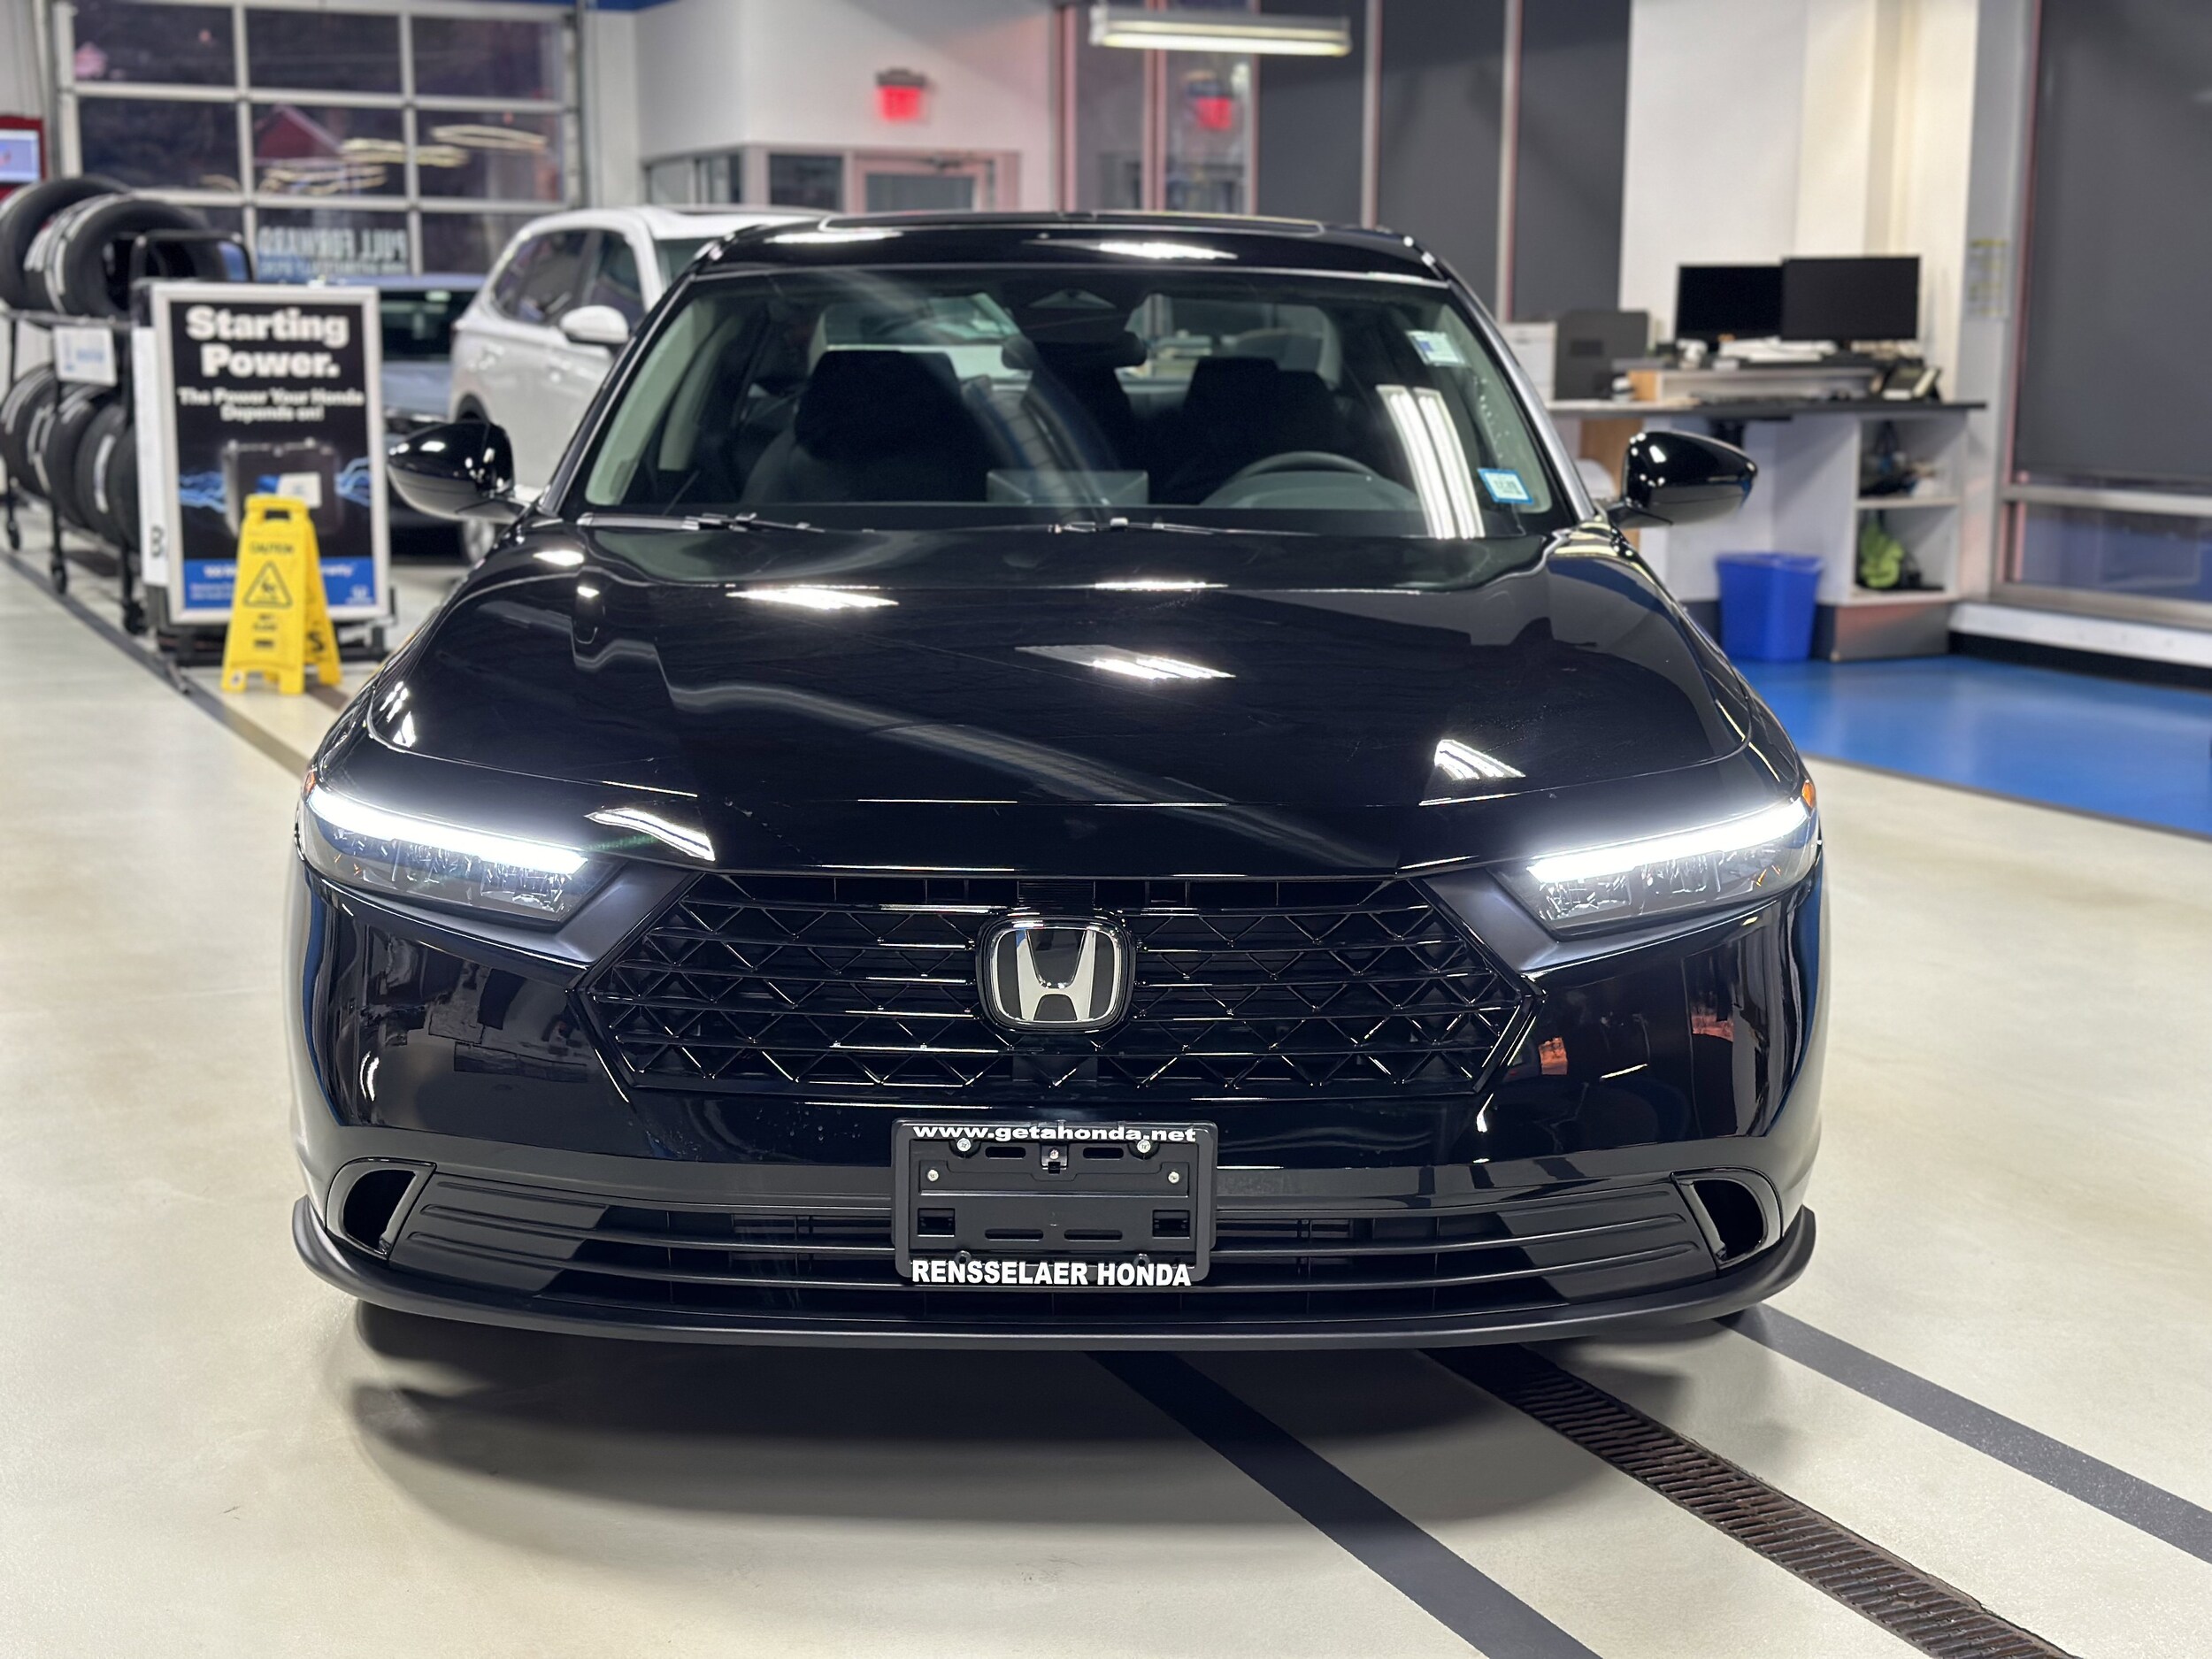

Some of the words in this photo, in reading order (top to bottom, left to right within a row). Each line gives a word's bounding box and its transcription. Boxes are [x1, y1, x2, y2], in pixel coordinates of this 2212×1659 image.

[186, 304, 349, 349] Starting
[200, 342, 341, 378] Power.
[178, 386, 211, 406] The
[212, 386, 267, 407] Power
[269, 387, 309, 407] Your
[310, 387, 365, 407] Honda
[220, 403, 295, 425] Depends
[912, 1125, 1196, 1142] www.getahonda.net
[911, 1259, 1088, 1285] RENSSELAER
[1097, 1263, 1191, 1286] HONDA
